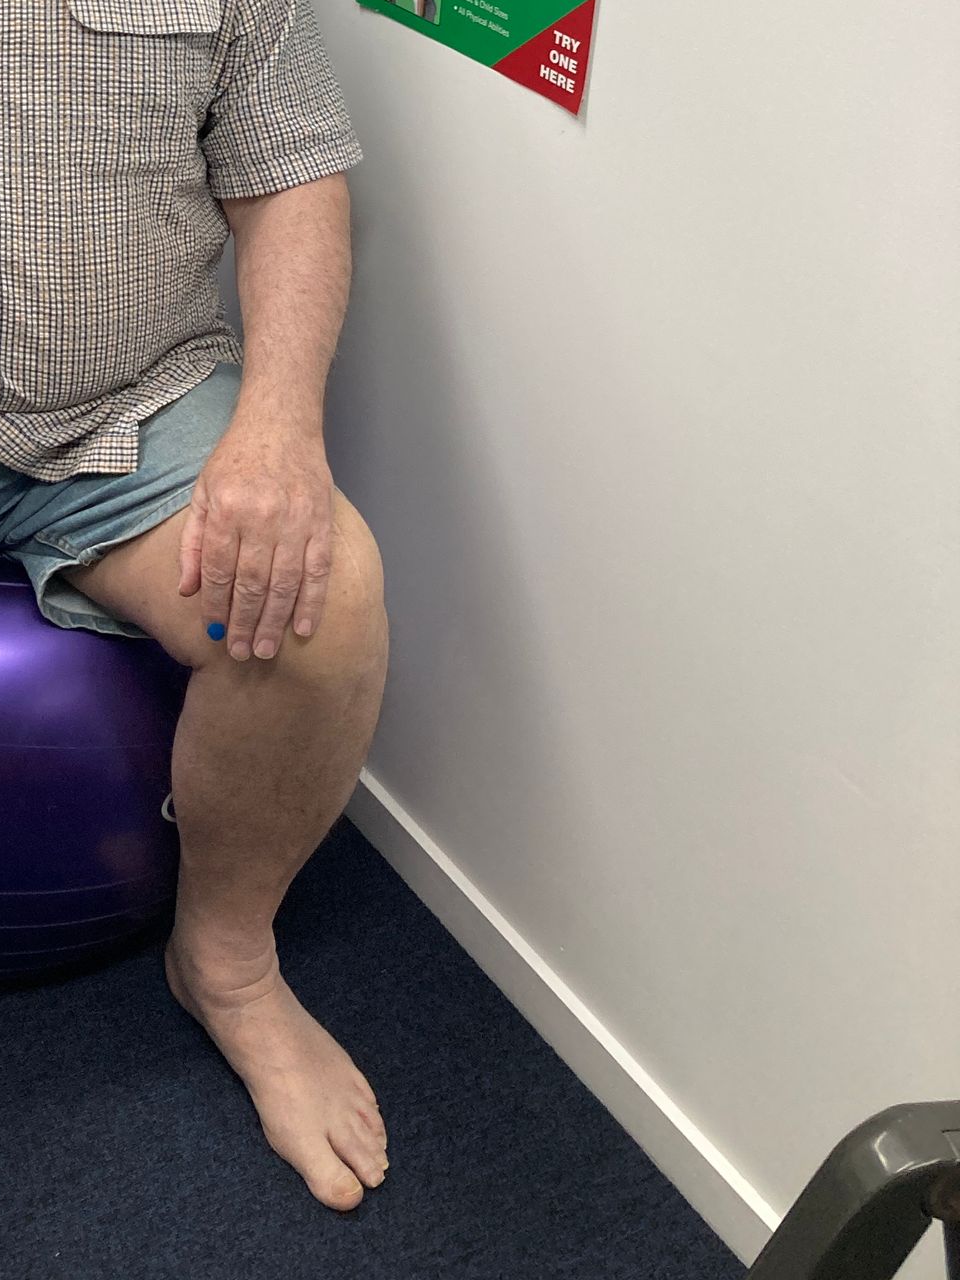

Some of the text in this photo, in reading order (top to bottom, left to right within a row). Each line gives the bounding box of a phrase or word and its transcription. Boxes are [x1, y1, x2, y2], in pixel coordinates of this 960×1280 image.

[458, 6, 510, 38] All Physical Abilities
[479, 0, 493, 13] Child
[493, 6, 509, 20] Sizes
[553, 29, 581, 53] TRY
[549, 49, 578, 74] ONE
[539, 64, 576, 94] HERE
